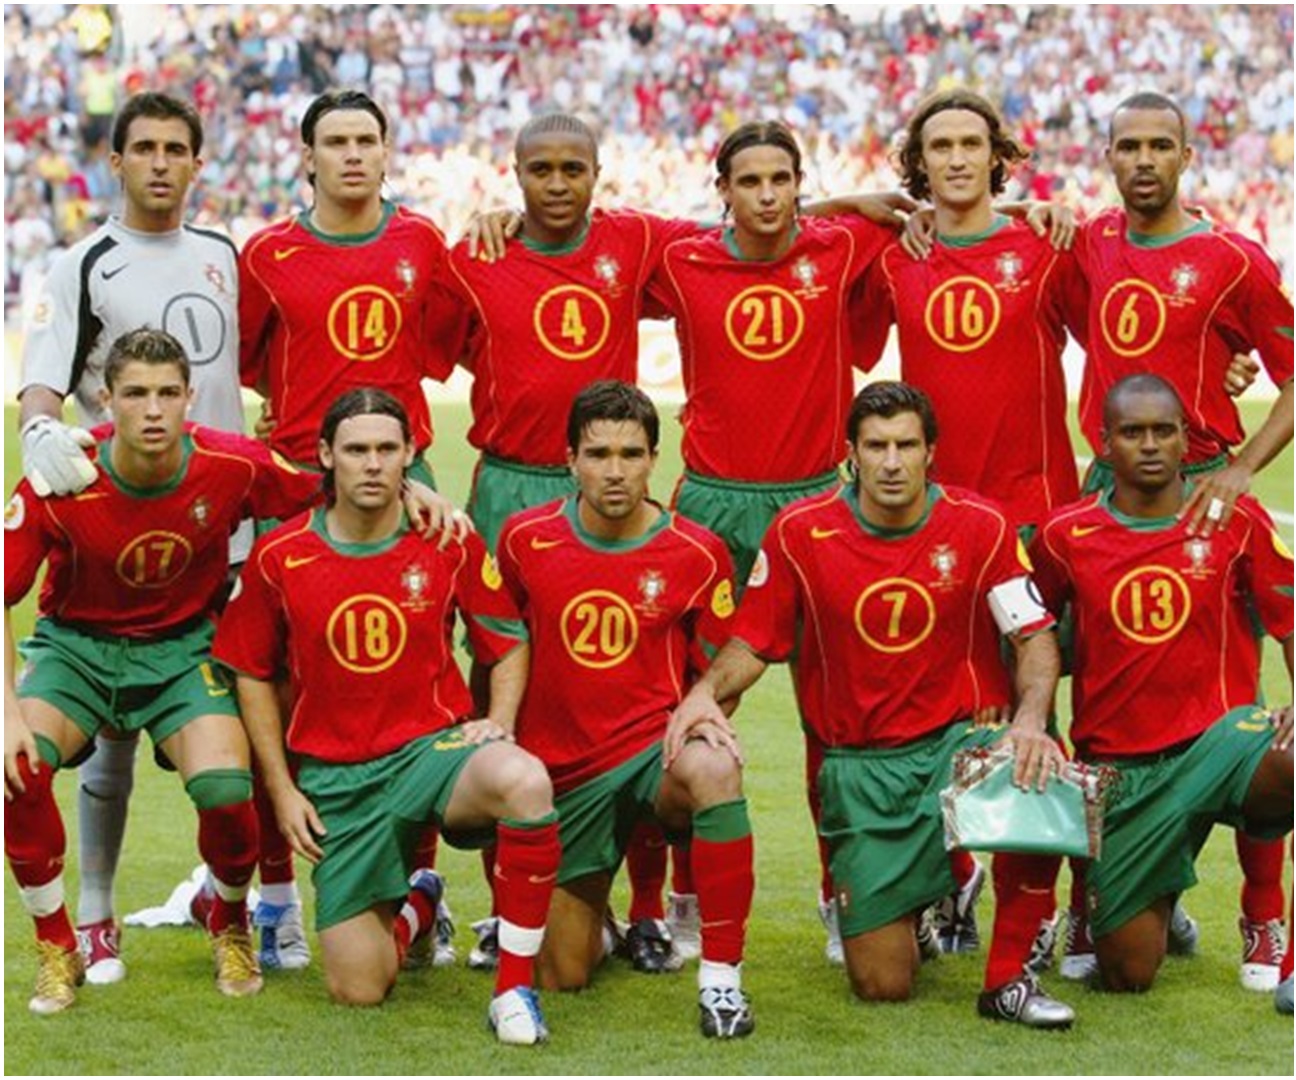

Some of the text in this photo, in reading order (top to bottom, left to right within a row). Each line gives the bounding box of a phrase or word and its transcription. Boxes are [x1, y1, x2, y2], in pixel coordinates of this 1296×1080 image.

[184, 306, 203, 353] 1
[347, 298, 388, 350] 14
[561, 298, 587, 347] 4
[741, 296, 785, 347] 21
[942, 290, 985, 340] 16
[1116, 292, 1141, 345] 6
[134, 541, 175, 583] 17
[573, 602, 626, 655] 20
[881, 590, 908, 639] 7
[1130, 578, 1175, 632] 13
[343, 607, 390, 660] 18
